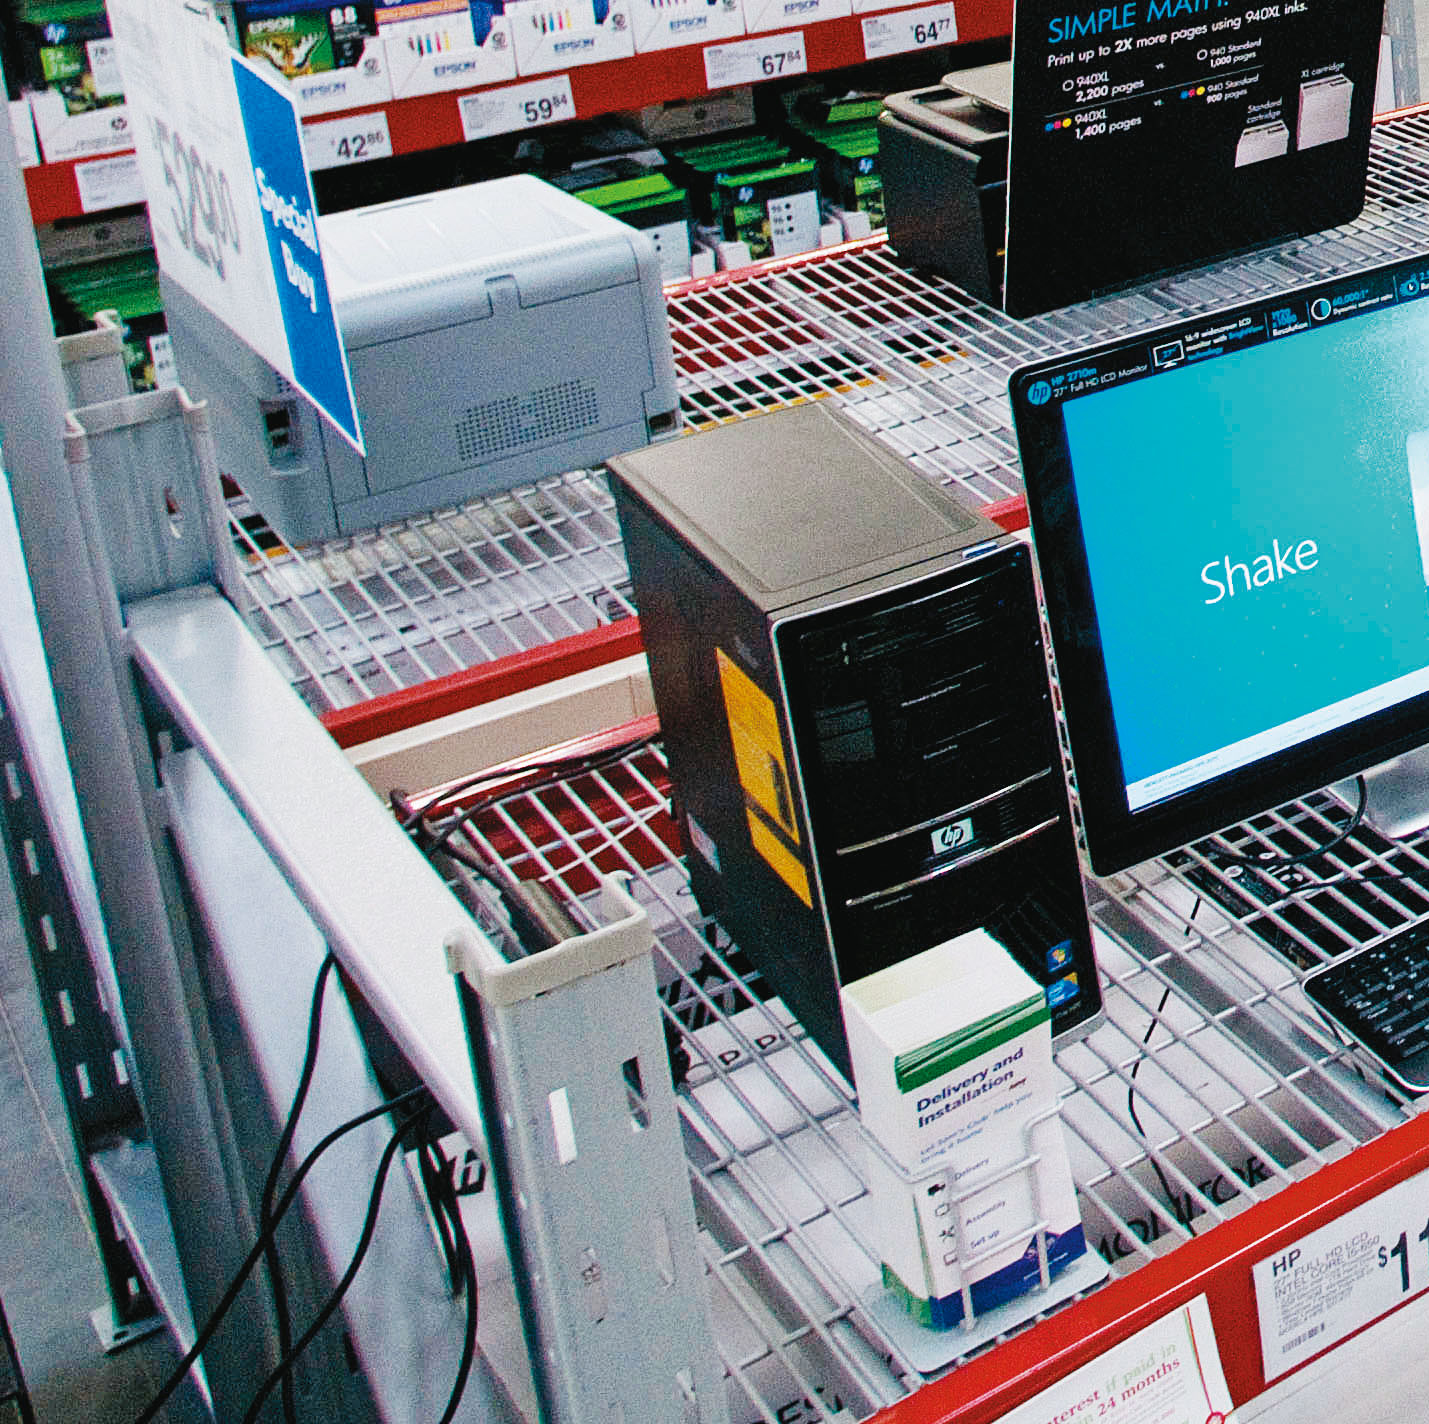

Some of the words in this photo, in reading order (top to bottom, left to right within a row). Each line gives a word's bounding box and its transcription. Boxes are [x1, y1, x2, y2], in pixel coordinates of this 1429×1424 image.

[1047, 50, 1075, 69] Print
[1078, 48, 1096, 65] up
[1098, 43, 1112, 57] to
[1114, 36, 1134, 53] 2X
[1136, 32, 1167, 49] more
[1171, 23, 1208, 45] pages
[1211, 14, 1242, 36] using
[1245, 4, 1281, 26] 940XL
[1283, 0, 1309, 17] inks.
[1048, 2, 1137, 45] SIMPLE
[1227, 36, 1263, 54] Standard
[1075, 69, 1110, 90] 940XL
[1209, 54, 1232, 69] 1,000
[1233, 49, 1257, 66] pages
[1075, 85, 1109, 103] 2,200
[1111, 77, 1145, 98] pages
[1074, 107, 1109, 127] 940XL
[1074, 121, 1107, 141] 1,400
[1108, 114, 1143, 136] pages
[255, 166, 319, 256] Special
[280, 238, 318, 314] Buy
[1118, 363, 1148, 381] Monitor
[1199, 534, 1321, 606] Shake
[916, 1060, 989, 1113] Delivery
[993, 1046, 1025, 1072] and
[917, 1067, 1015, 1128] Installation
[1271, 1247, 1303, 1277] HP
[1097, 1398, 1117, 1418] 24
[1120, 1357, 1182, 1402] months
[1121, 1351, 1156, 1390] paid
[1161, 1342, 1177, 1363] in
